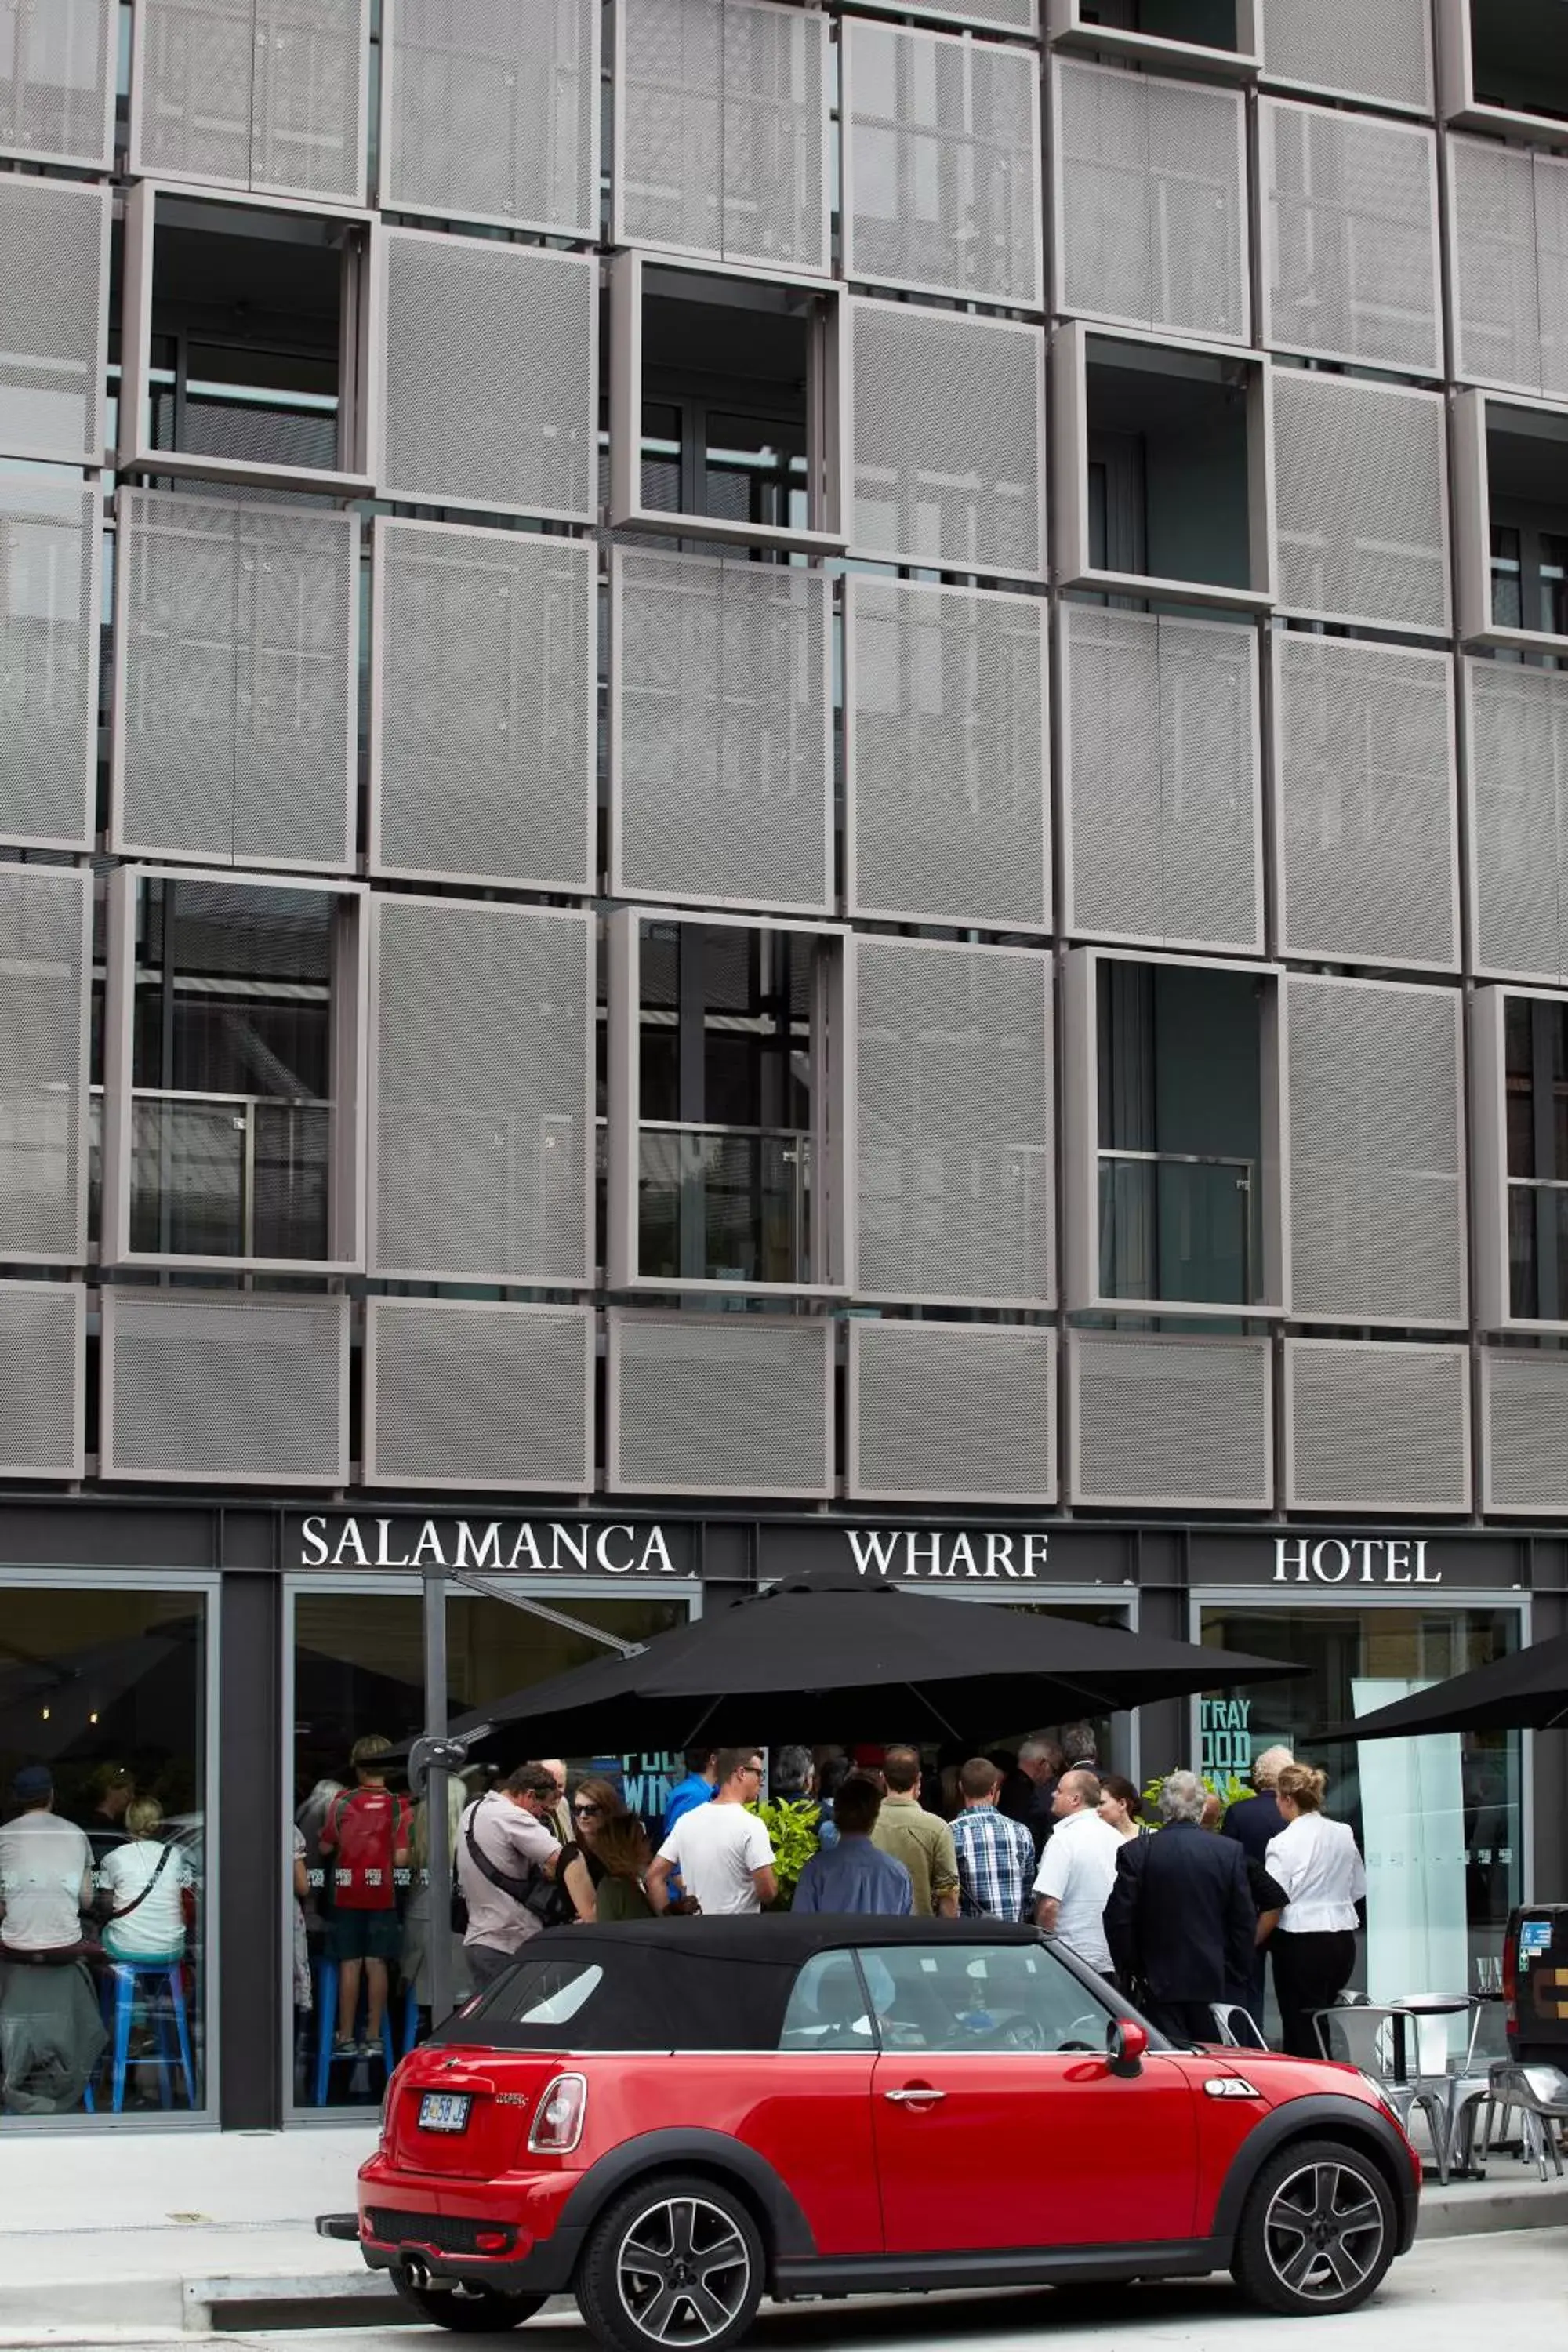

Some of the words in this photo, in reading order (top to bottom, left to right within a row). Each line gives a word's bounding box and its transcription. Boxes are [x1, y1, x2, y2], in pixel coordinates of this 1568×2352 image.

[301, 1517, 676, 1572] SALAMANCA
[847, 1530, 1048, 1577] WHARF
[1272, 1539, 1442, 1583] HOTEL
[1200, 1700, 1251, 1730] TRAY
[1200, 1731, 1252, 1767] OOD
[622, 1774, 674, 1817] WIN
